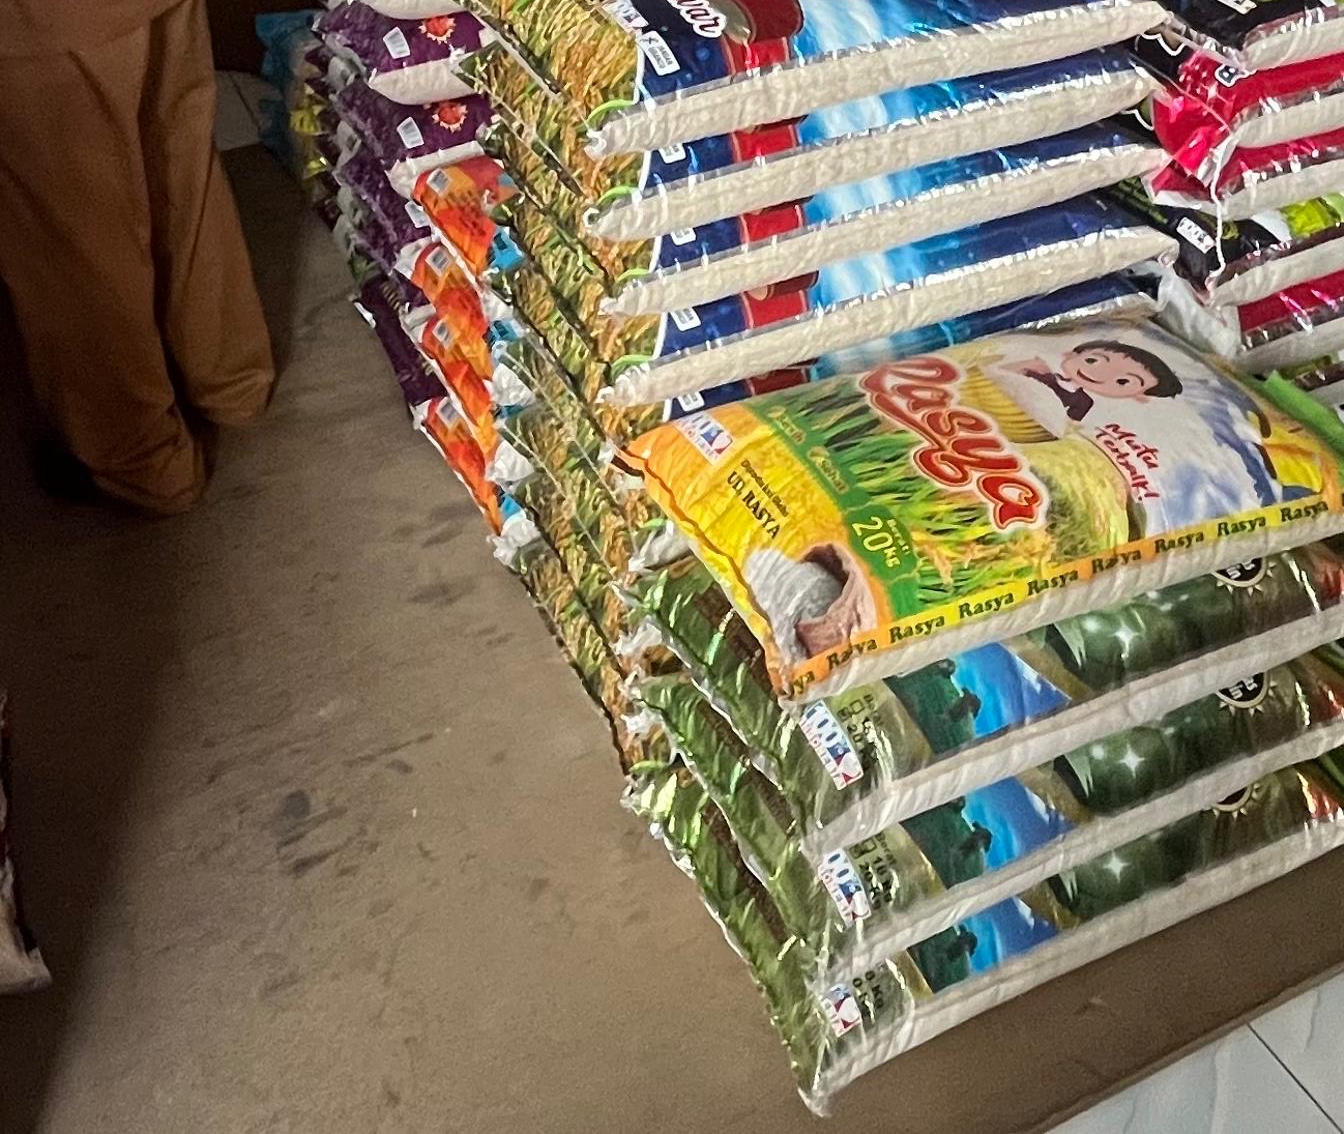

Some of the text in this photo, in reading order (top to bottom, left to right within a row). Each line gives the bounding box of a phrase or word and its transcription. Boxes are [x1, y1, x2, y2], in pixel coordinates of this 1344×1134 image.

[858, 355, 1051, 535] Rasya
[1105, 423, 1159, 469] Mutu
[741, 489, 782, 541] RASYA
[851, 515, 895, 552] 20
[888, 613, 946, 646] Rasya
[957, 589, 1016, 619] Rasya
[1026, 566, 1080, 597] Rasya
[1153, 527, 1206, 555] Rasya
[1215, 512, 1268, 538] Rasya
[1279, 499, 1330, 524] Rasya
